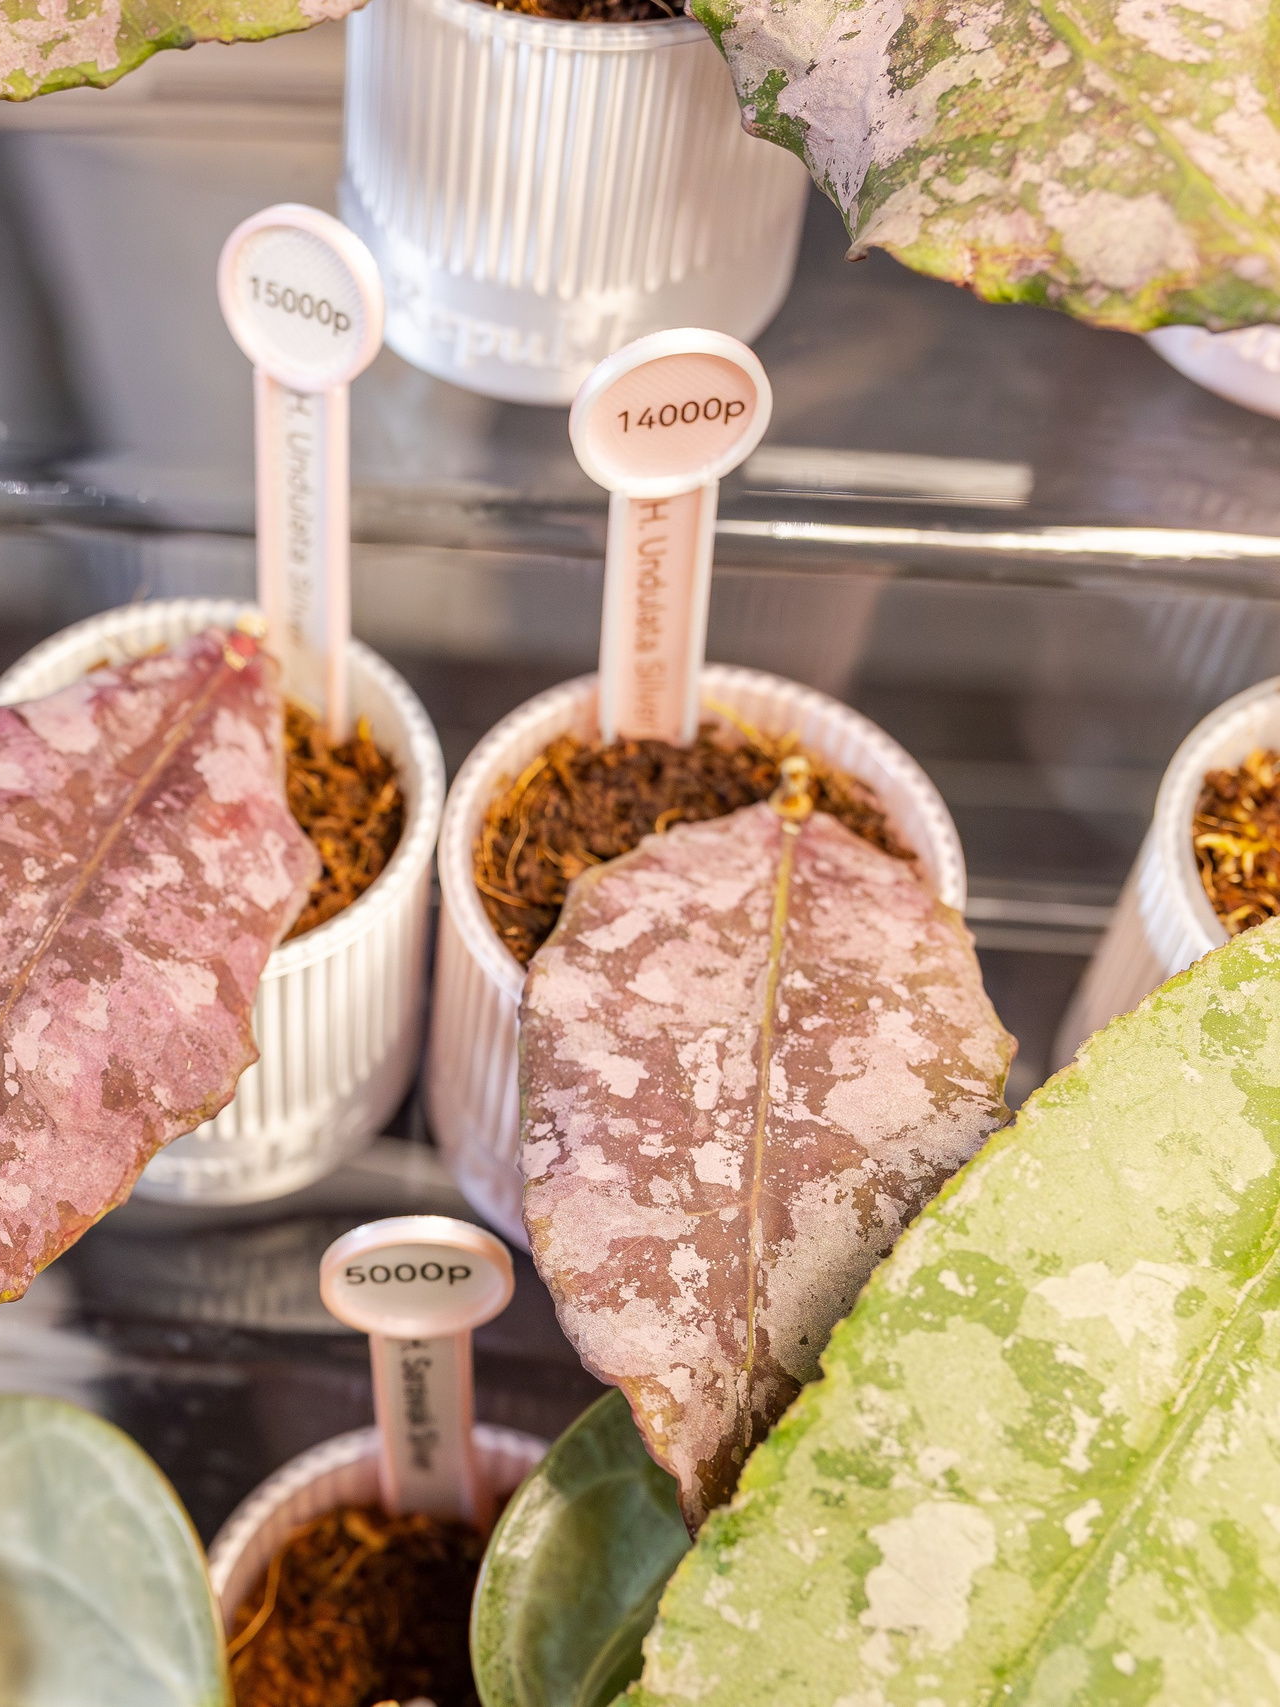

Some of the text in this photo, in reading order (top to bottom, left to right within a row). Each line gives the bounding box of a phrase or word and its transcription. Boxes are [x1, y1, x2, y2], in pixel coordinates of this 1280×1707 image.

[249, 275, 352, 337] 15000p
[617, 396, 746, 434] 14000p
[285, 429, 314, 567] Undulata
[637, 500, 670, 532] H.
[634, 534, 670, 655] Undulata
[345, 1261, 472, 1286] 5000p
